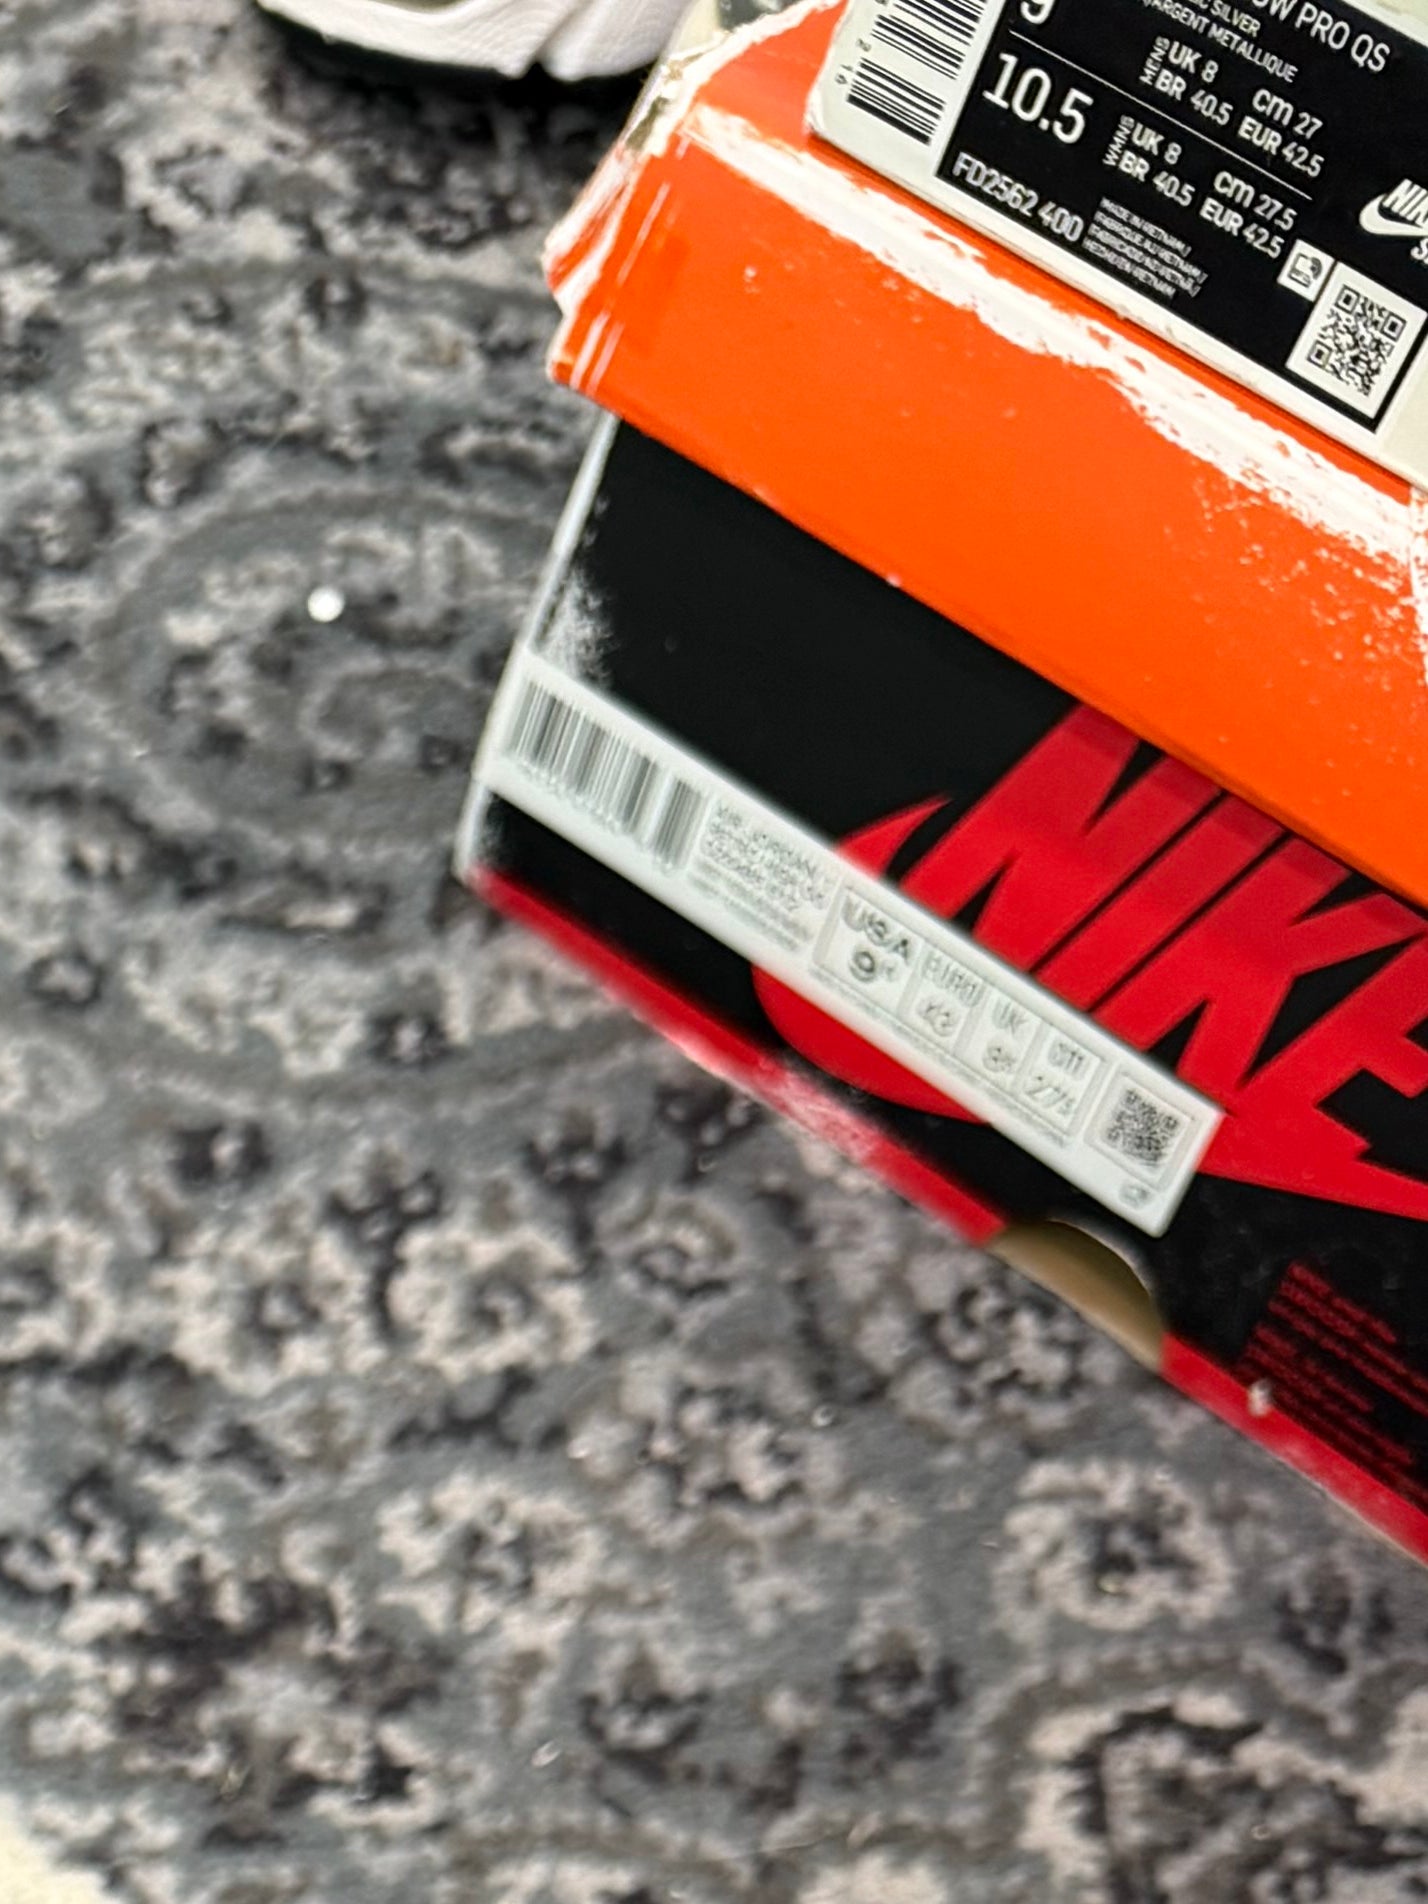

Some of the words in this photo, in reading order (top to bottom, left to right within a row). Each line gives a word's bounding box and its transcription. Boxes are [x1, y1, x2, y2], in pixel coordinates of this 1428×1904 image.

[1207, 23, 1299, 83] METALLIQUE
[1210, 0, 1261, 38] SILVER
[1295, 2, 1350, 50] PRO
[1351, 33, 1391, 72] QS
[982, 52, 1094, 144] 10.5
[1155, 68, 1187, 100] BR
[1190, 89, 1233, 126] 40.5
[1238, 115, 1282, 155] EUR
[1282, 142, 1325, 178] 42.5
[1168, 41, 1202, 74] UK
[1201, 60, 1219, 83] 8
[1293, 112, 1323, 139] 27
[1132, 122, 1165, 156] UK
[1164, 142, 1182, 165] 8
[952, 151, 1039, 218] FD2562
[1038, 201, 1084, 243] 400
[1118, 149, 1150, 182] BR
[1152, 171, 1196, 207] 40.5
[1199, 197, 1244, 237] EUR
[1243, 222, 1285, 259] 42.5
